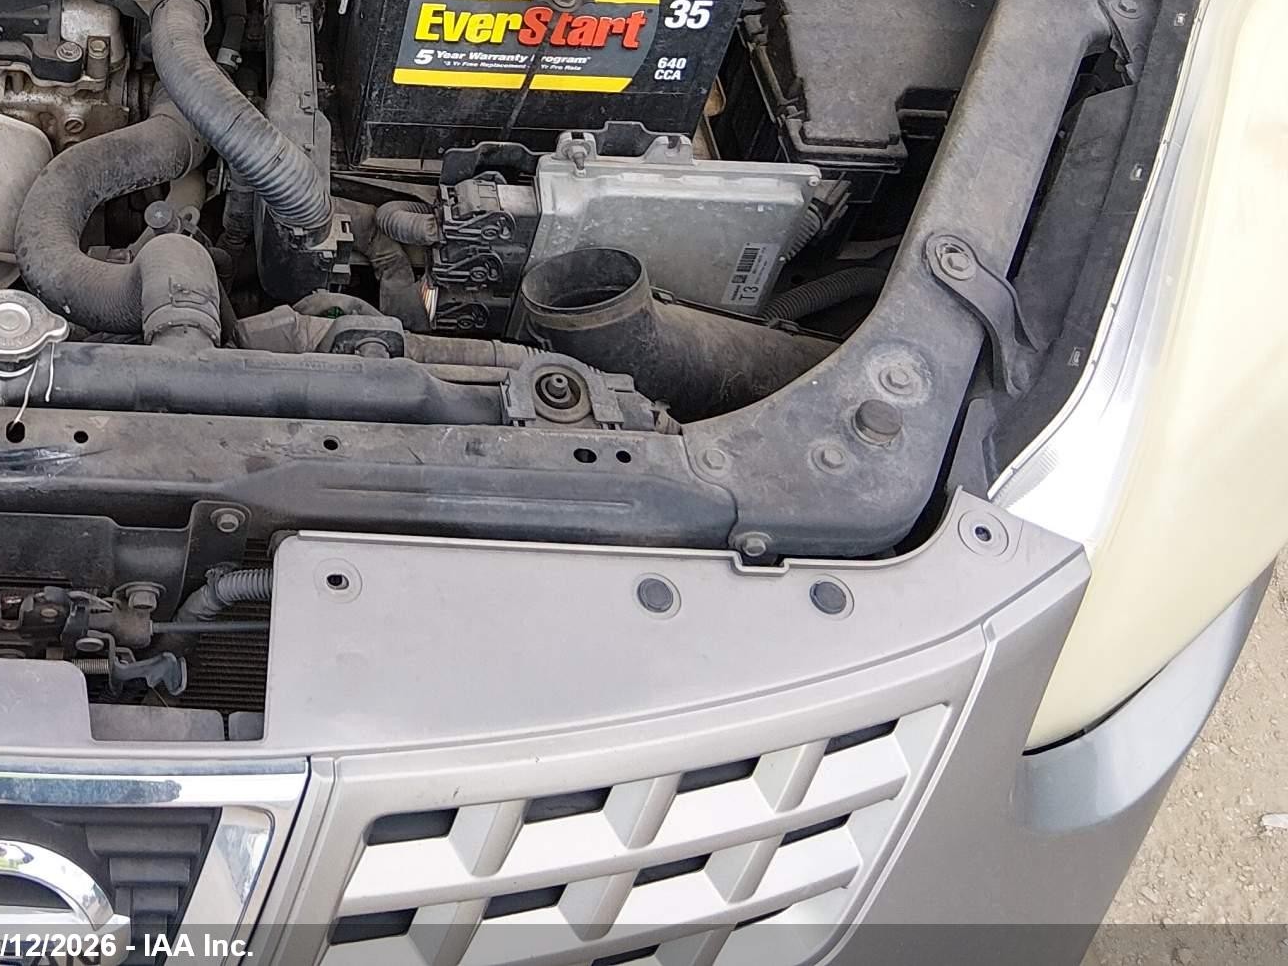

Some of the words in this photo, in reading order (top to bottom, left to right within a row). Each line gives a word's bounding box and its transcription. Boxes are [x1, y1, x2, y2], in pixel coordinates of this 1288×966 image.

[664, 0, 714, 30] 35
[414, 2, 648, 49] EverStart
[414, 48, 435, 65] 5
[436, 50, 467, 60] Year
[468, 52, 529, 63] Warranty
[657, 57, 687, 70] 640
[654, 70, 682, 81] CCA
